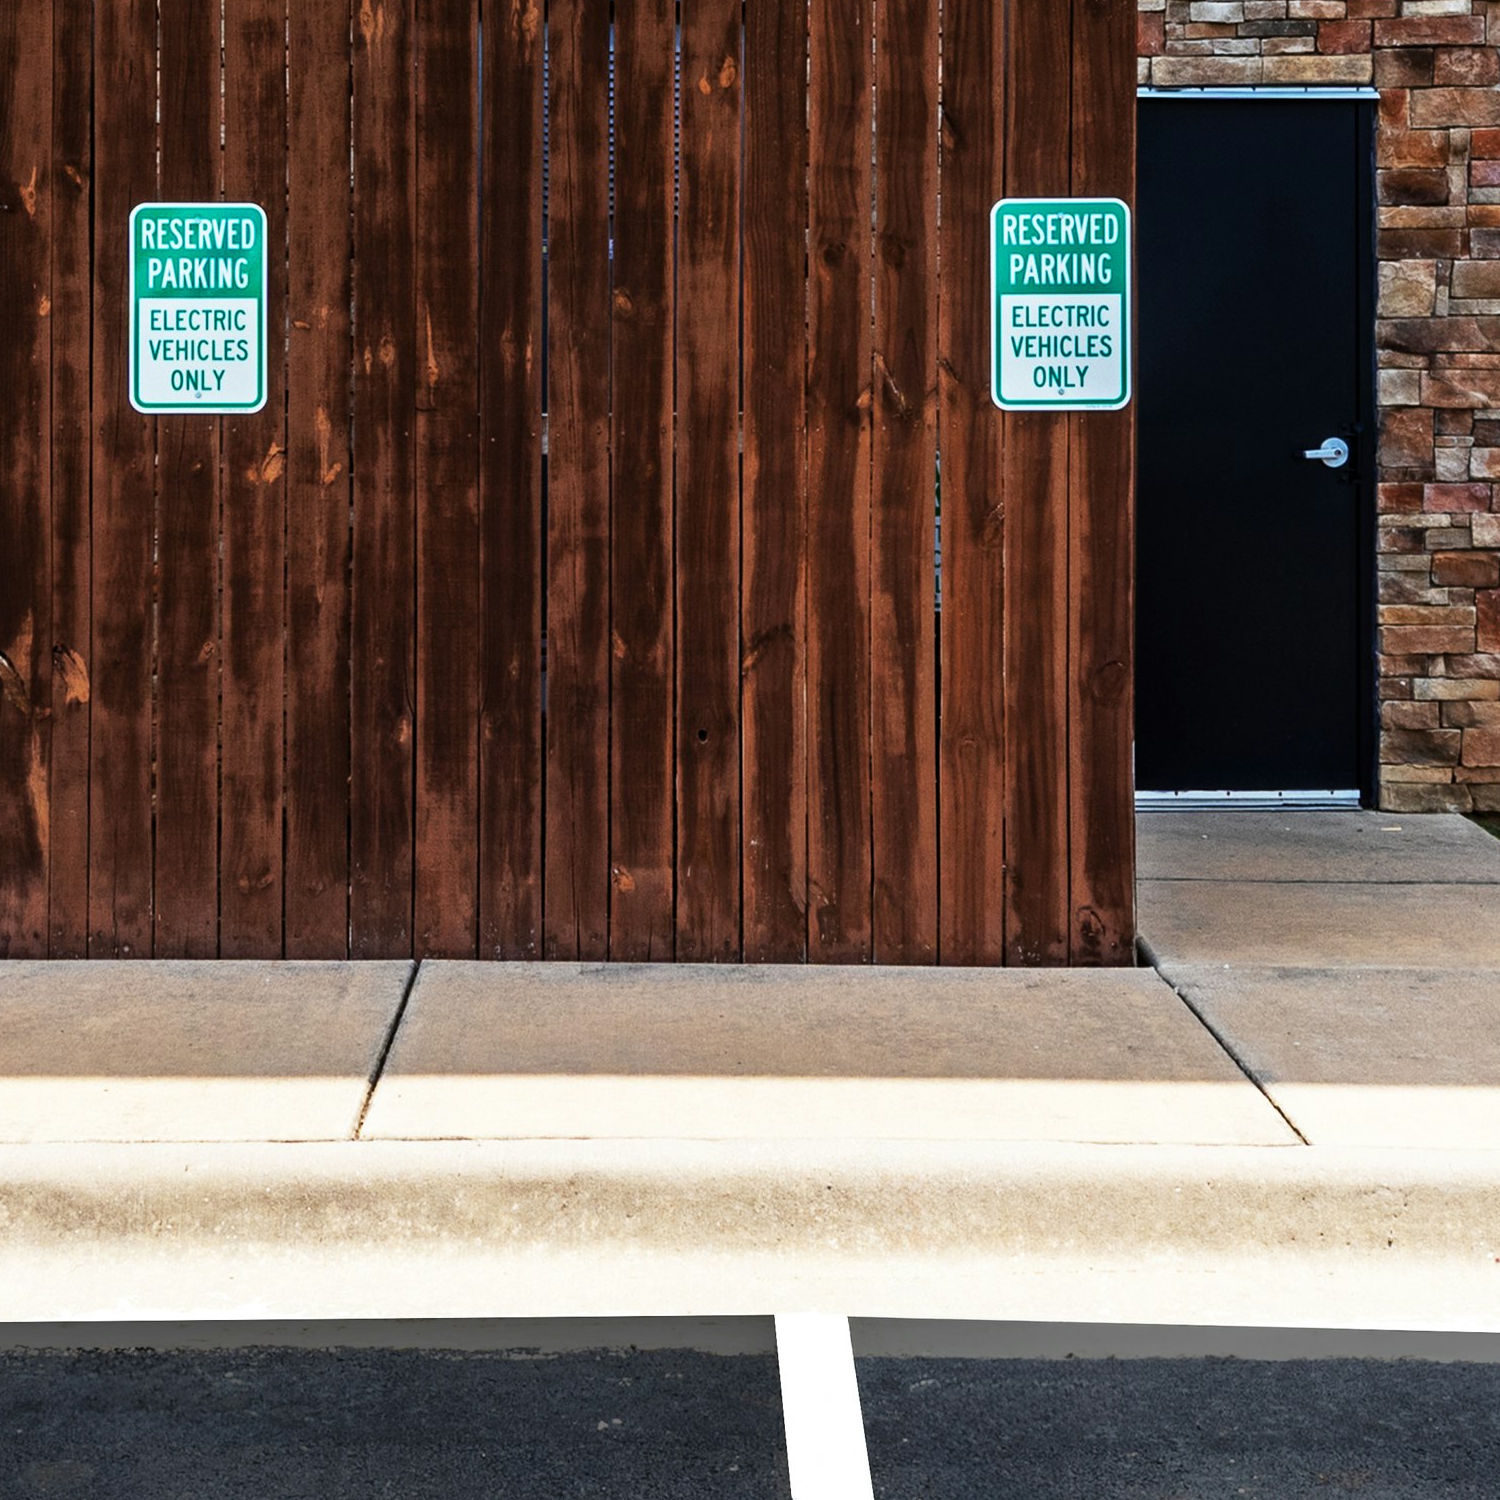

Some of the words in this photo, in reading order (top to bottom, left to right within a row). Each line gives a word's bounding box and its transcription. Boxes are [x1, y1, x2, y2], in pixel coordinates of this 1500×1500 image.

[141, 218, 256, 250] RESERVED
[1002, 213, 1119, 245] RESERVED
[148, 257, 249, 289] PARKING
[1010, 253, 1112, 285] PARKING
[150, 309, 246, 331] ELECTRIC
[1012, 305, 1110, 327] ELECTRIC
[149, 339, 249, 361] VEHICLES
[1011, 335, 1112, 358] VEHICLES
[171, 369, 225, 391] ONLY
[1033, 365, 1089, 388] ONLY
